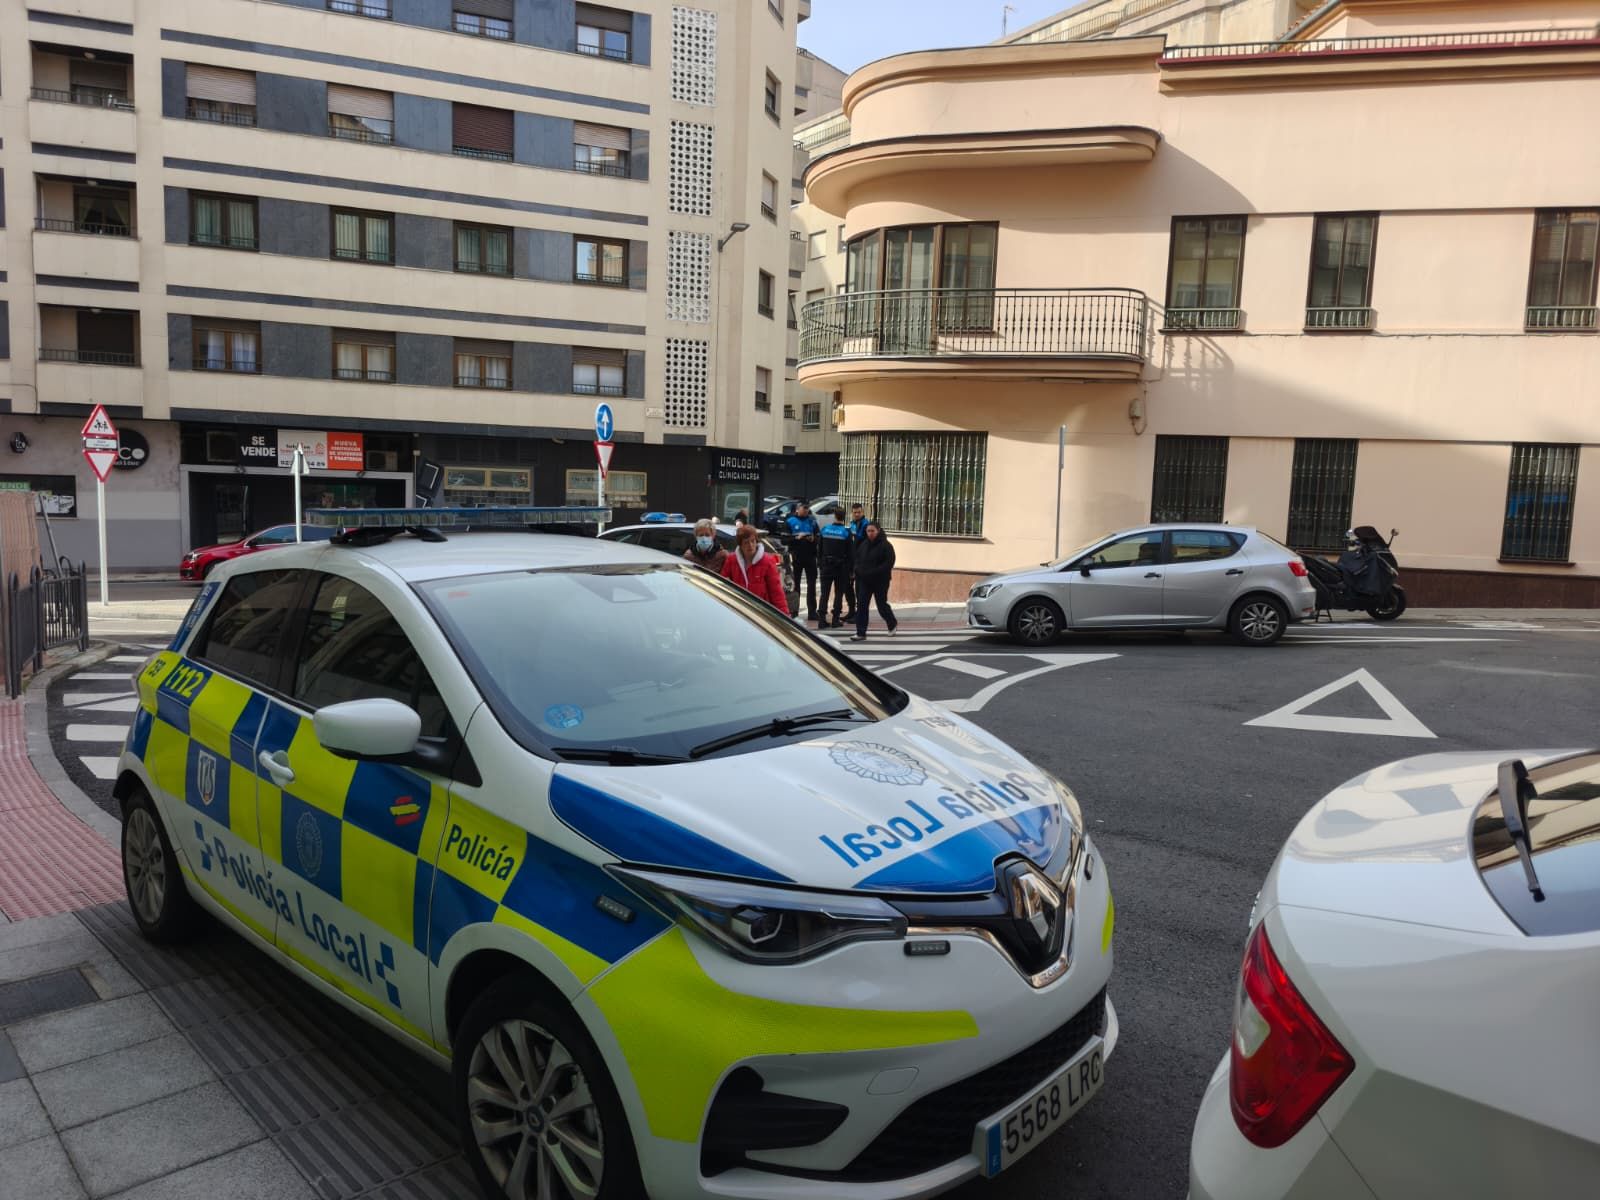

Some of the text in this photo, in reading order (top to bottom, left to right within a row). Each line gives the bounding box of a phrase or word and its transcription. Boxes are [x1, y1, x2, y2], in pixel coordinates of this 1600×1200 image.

[241, 446, 276, 457] VENDE
[252, 436, 265, 446] SE
[0, 481, 31, 490] ENDE
[445, 823, 515, 881] Policía
[213, 836, 373, 985] Policía Local
[1005, 1051, 1101, 1155] 5568 LRC
